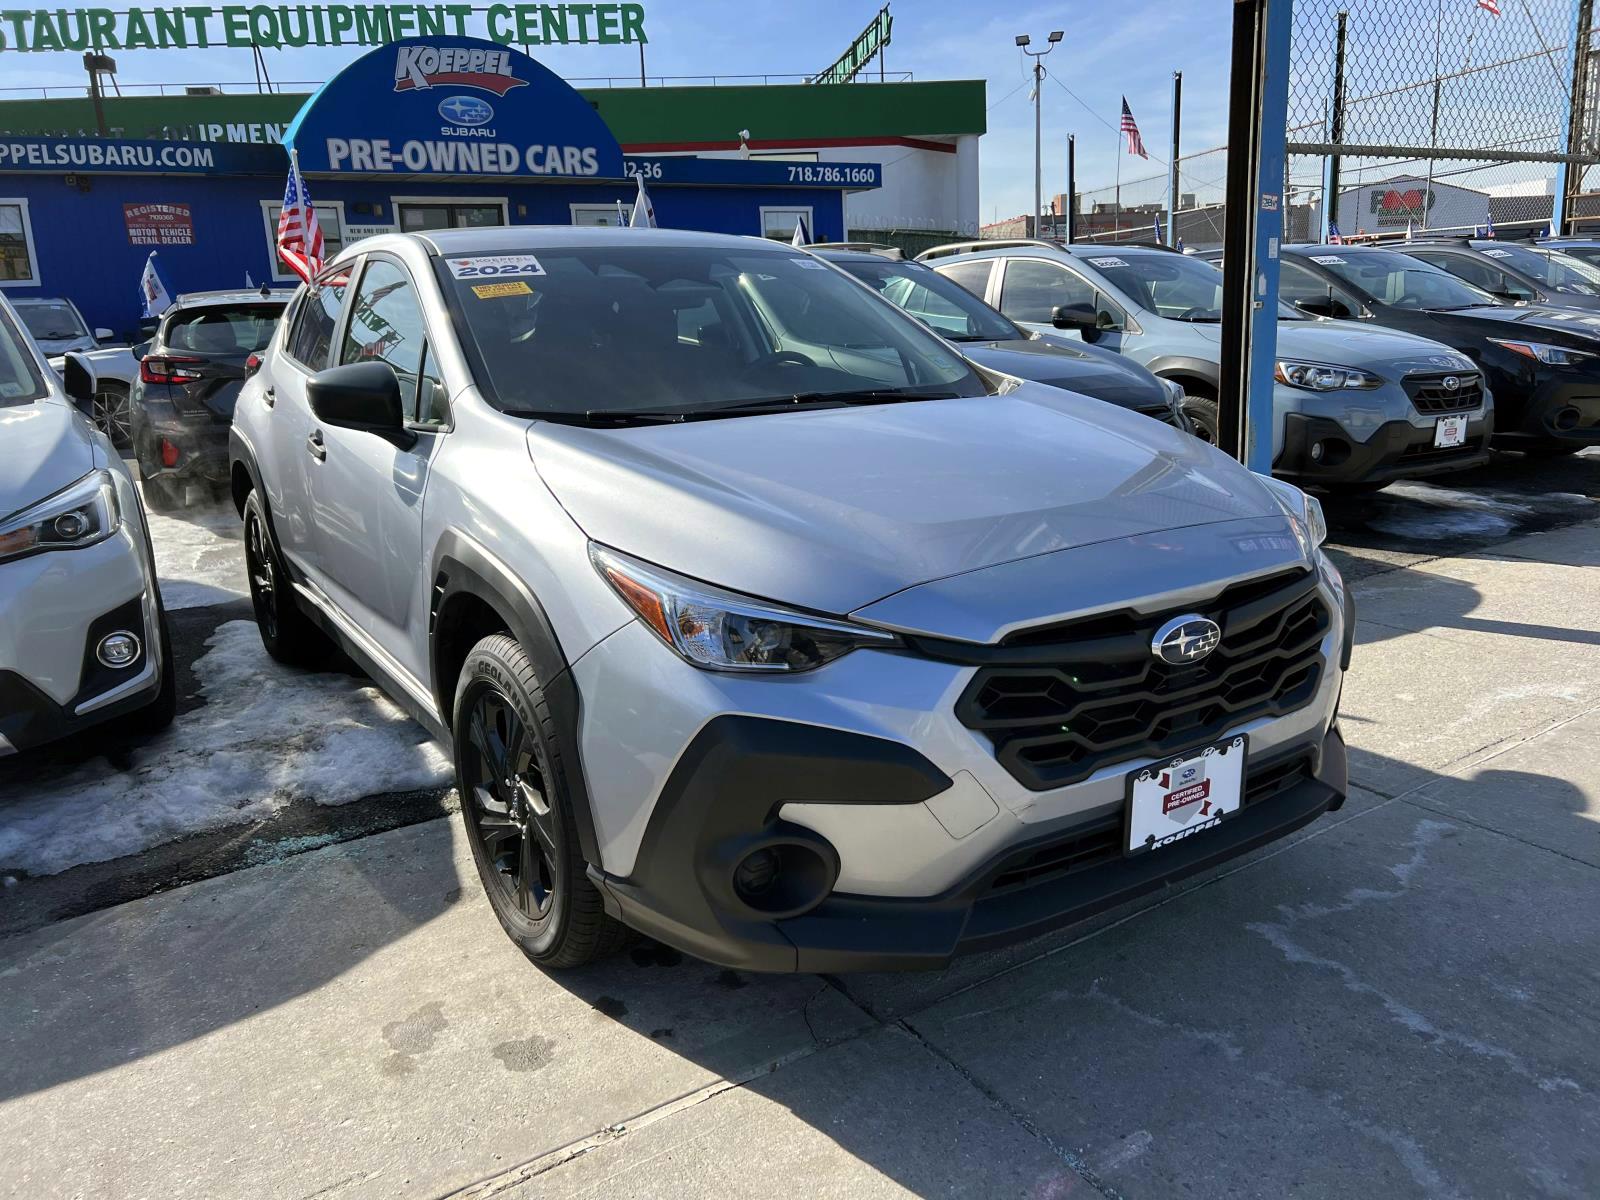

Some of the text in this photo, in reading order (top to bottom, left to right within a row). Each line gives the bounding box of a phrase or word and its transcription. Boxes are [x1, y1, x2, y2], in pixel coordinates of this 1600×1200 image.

[0, 3, 648, 52] TAURANT EQUIPMENT CENTER
[395, 46, 513, 90] KOEPPEL
[441, 127, 496, 137] SUBARU
[326, 138, 599, 175] PRE-OWNED CARS
[787, 166, 875, 182] 718.786.1660
[126, 204, 190, 217] REGISTERED
[128, 228, 192, 236] MOTOR VEHICLE
[131, 236, 192, 245] RETAIL DEALER
[457, 264, 541, 277] 2024
[1167, 791, 1205, 809] PRE-OWNED
[1170, 785, 1203, 801] CERTIFIED
[1151, 817, 1222, 851] KOEPPEL
